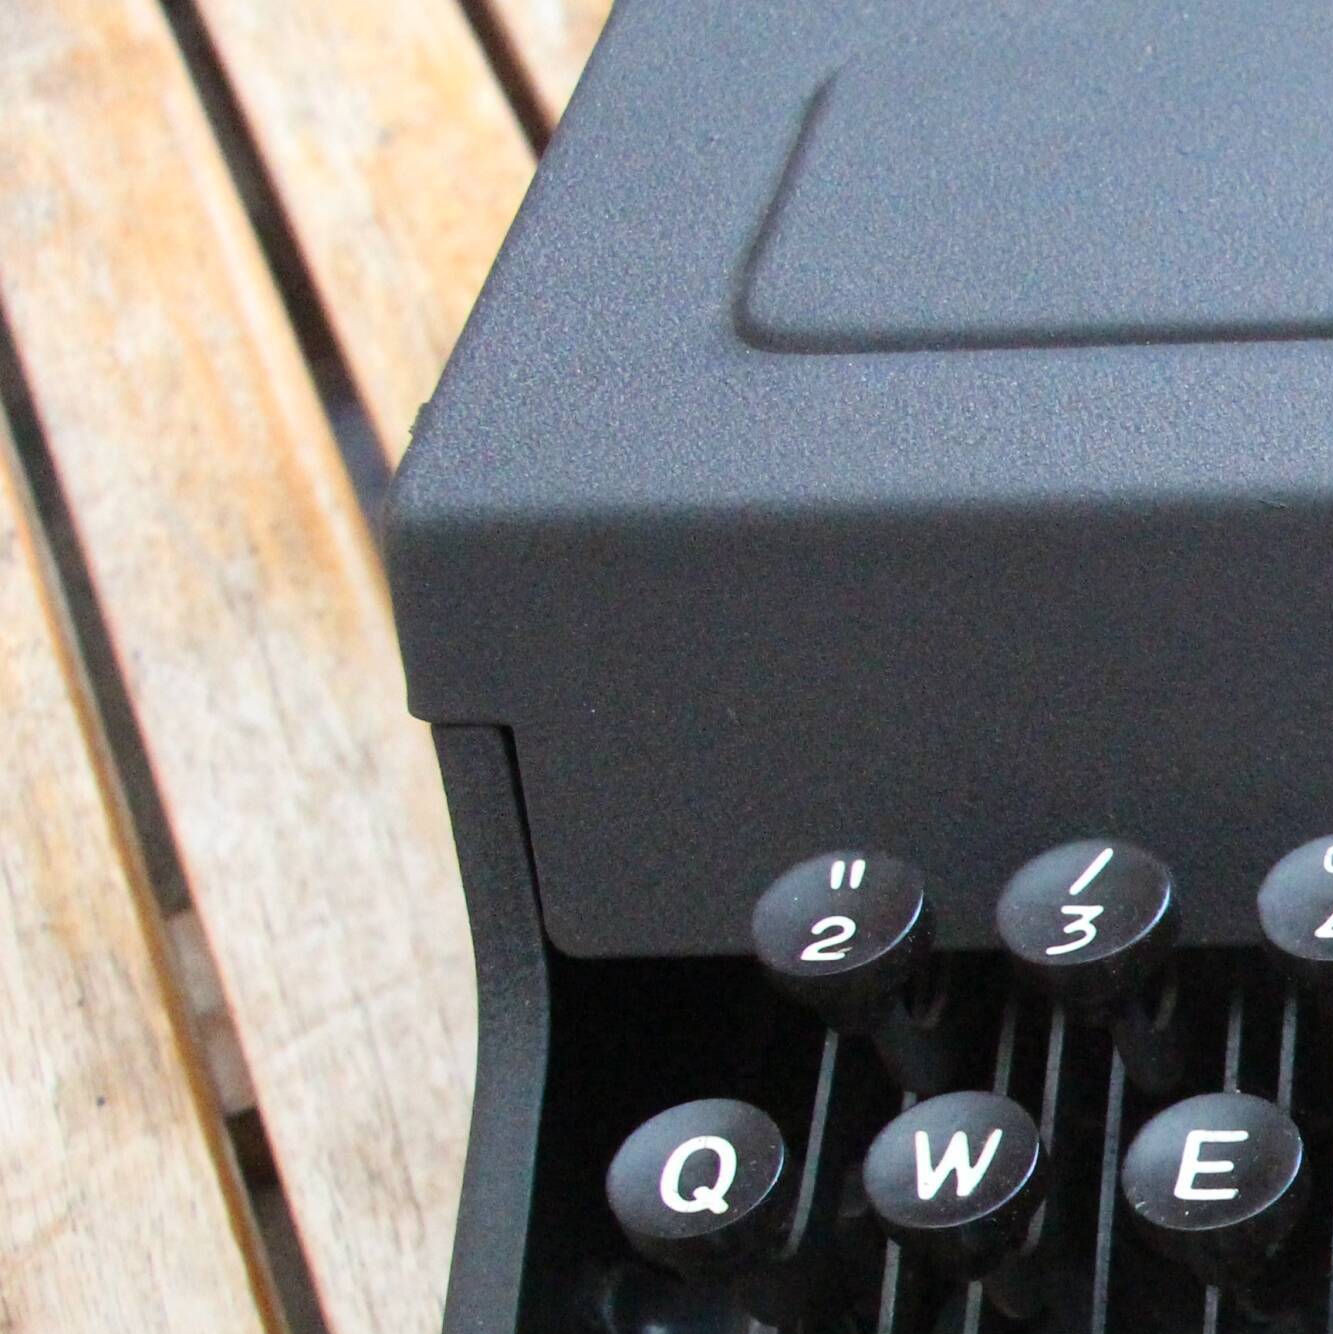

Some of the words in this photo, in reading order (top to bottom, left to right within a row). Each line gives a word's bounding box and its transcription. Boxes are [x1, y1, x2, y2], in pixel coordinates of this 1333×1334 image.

[1068, 846, 1114, 896] /
[799, 914, 858, 963] 2
[1045, 904, 1105, 956] 3
[659, 1135, 738, 1215] Q
[914, 1127, 1004, 1202] W
[1173, 1128, 1249, 1202] E
